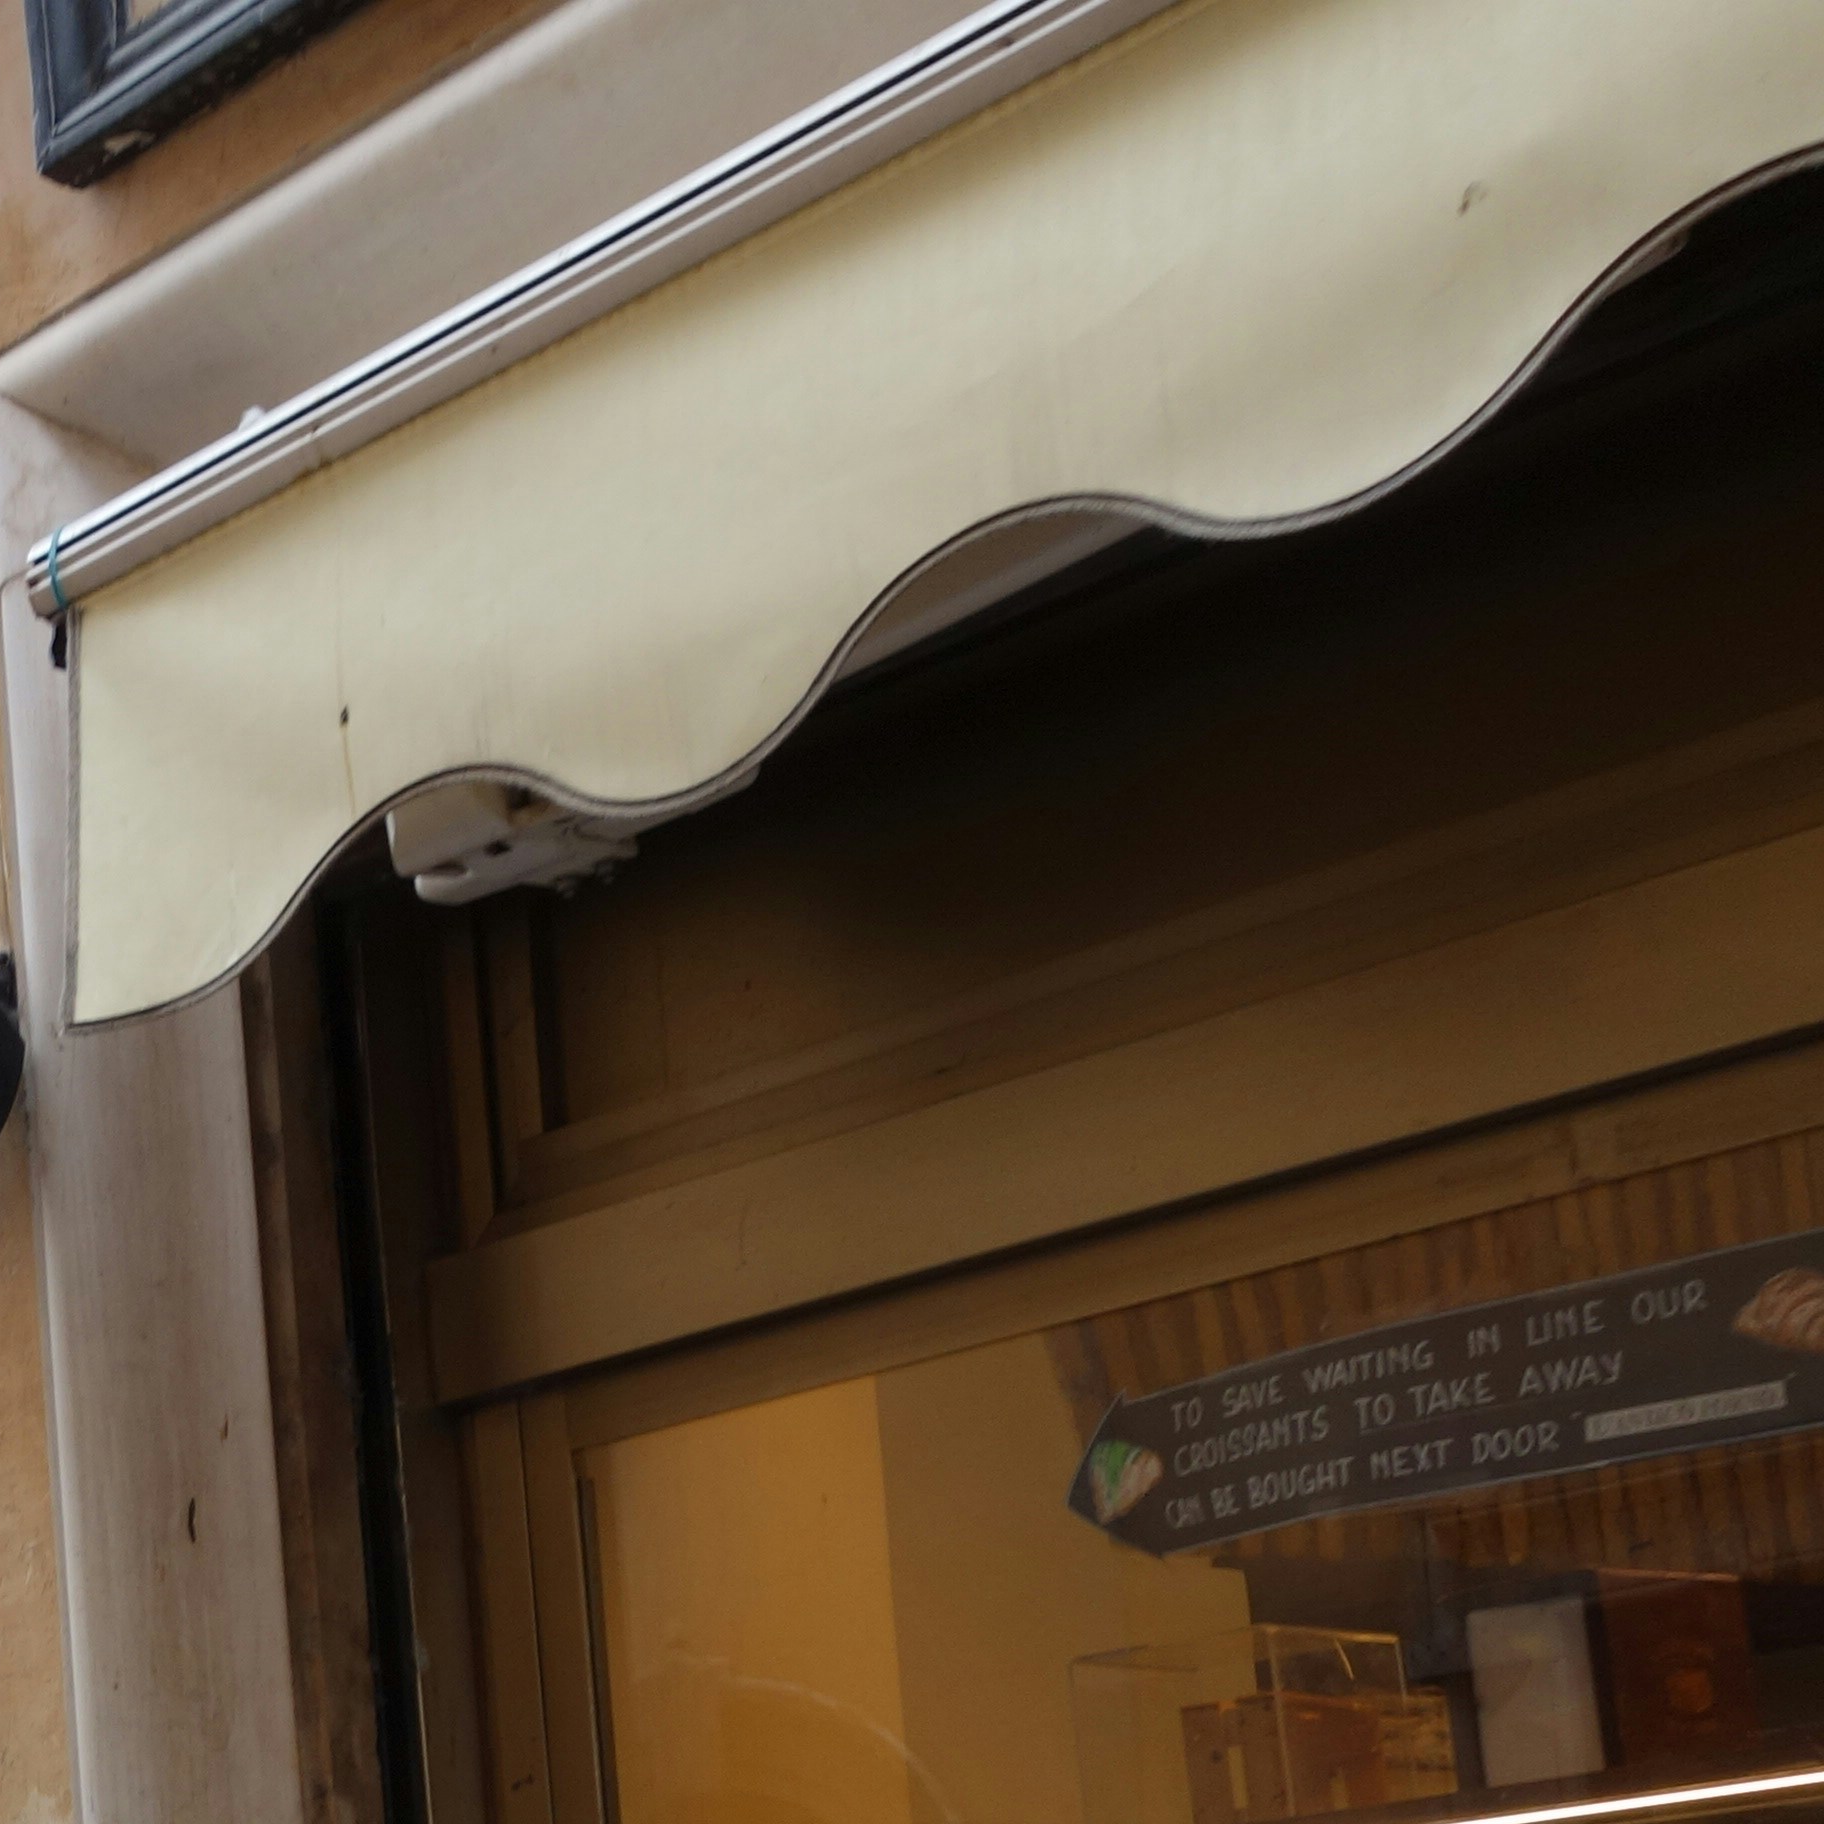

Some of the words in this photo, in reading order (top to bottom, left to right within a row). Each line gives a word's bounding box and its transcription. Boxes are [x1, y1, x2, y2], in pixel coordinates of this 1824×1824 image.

[1171, 1397, 1204, 1433] TO
[1222, 1374, 1286, 1418] SAVE
[1303, 1339, 1435, 1394] WAITING
[1466, 1323, 1502, 1359] IN
[1525, 1299, 1606, 1347] LINE
[1631, 1279, 1709, 1325] OUR
[1174, 1404, 1330, 1477] CROISSANTS
[1354, 1393, 1396, 1431] TO
[1408, 1372, 1496, 1417] TAKE
[1519, 1350, 1624, 1399] AWAY
[1211, 1485, 1241, 1519] BE
[1247, 1456, 1355, 1510] BOUGHT
[1370, 1439, 1454, 1480] NEXT
[1472, 1421, 1560, 1465] DOOR
